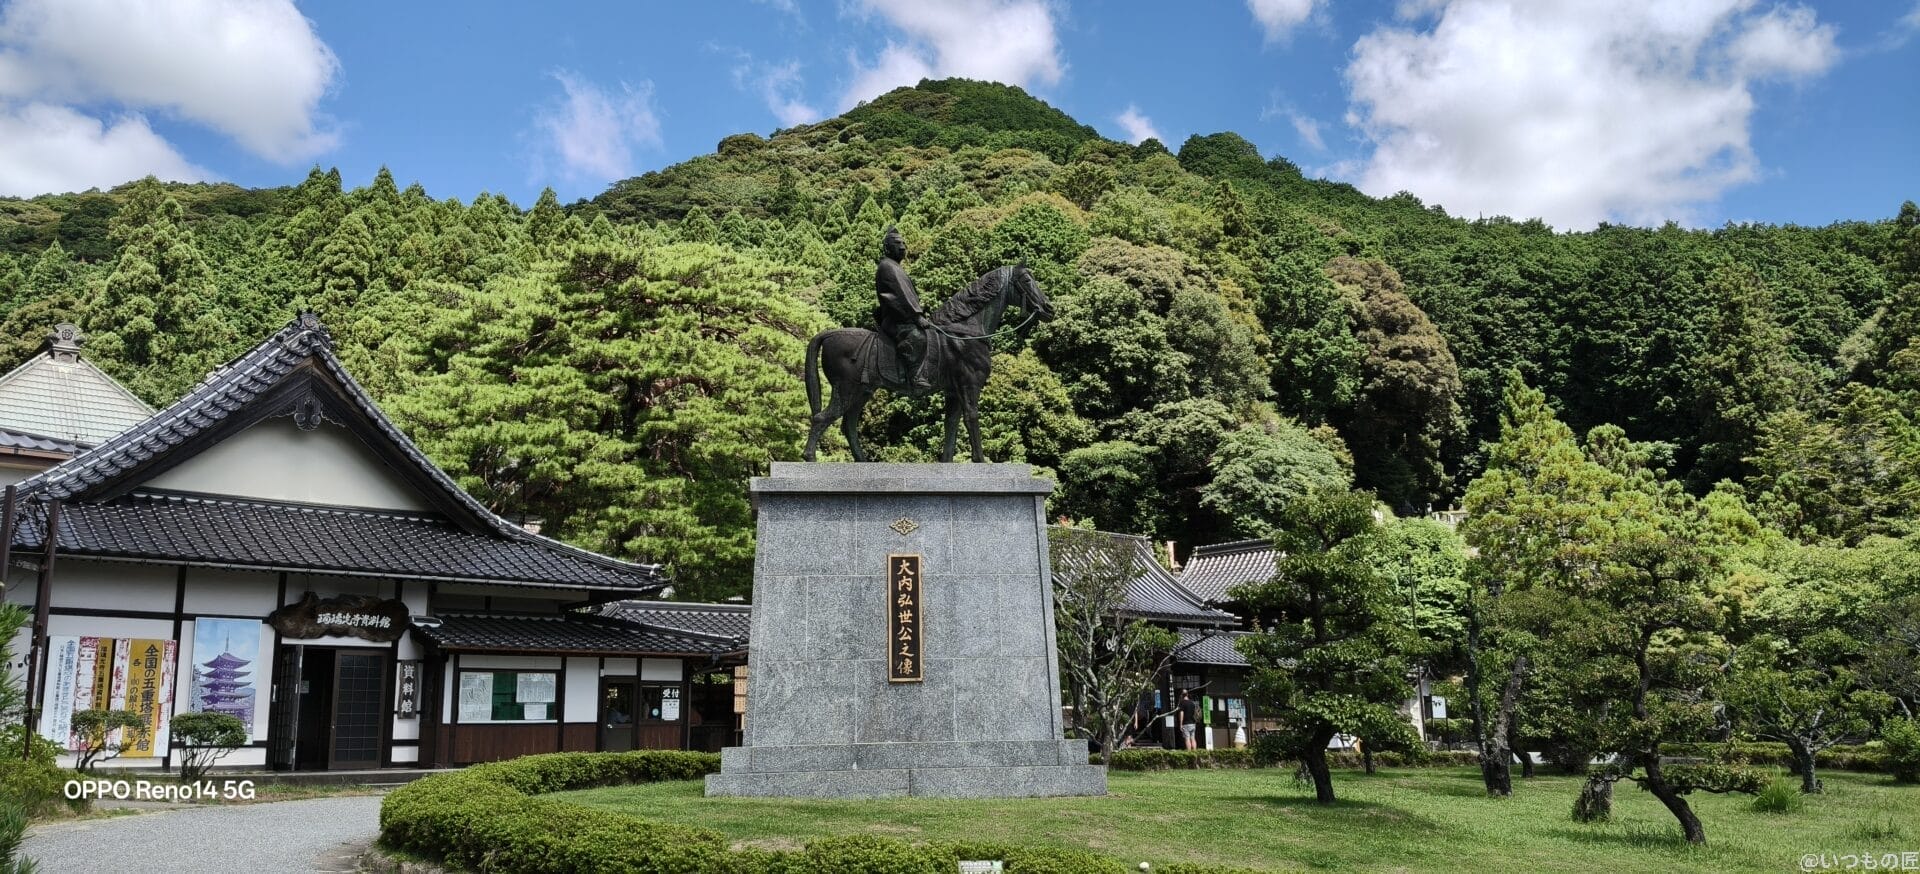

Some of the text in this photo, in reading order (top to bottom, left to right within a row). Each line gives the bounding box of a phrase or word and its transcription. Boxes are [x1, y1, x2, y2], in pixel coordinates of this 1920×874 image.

[897, 559, 915, 675] 大内弘世公之像
[401, 665, 415, 713] 資料館
[662, 688, 680, 698] 受付
